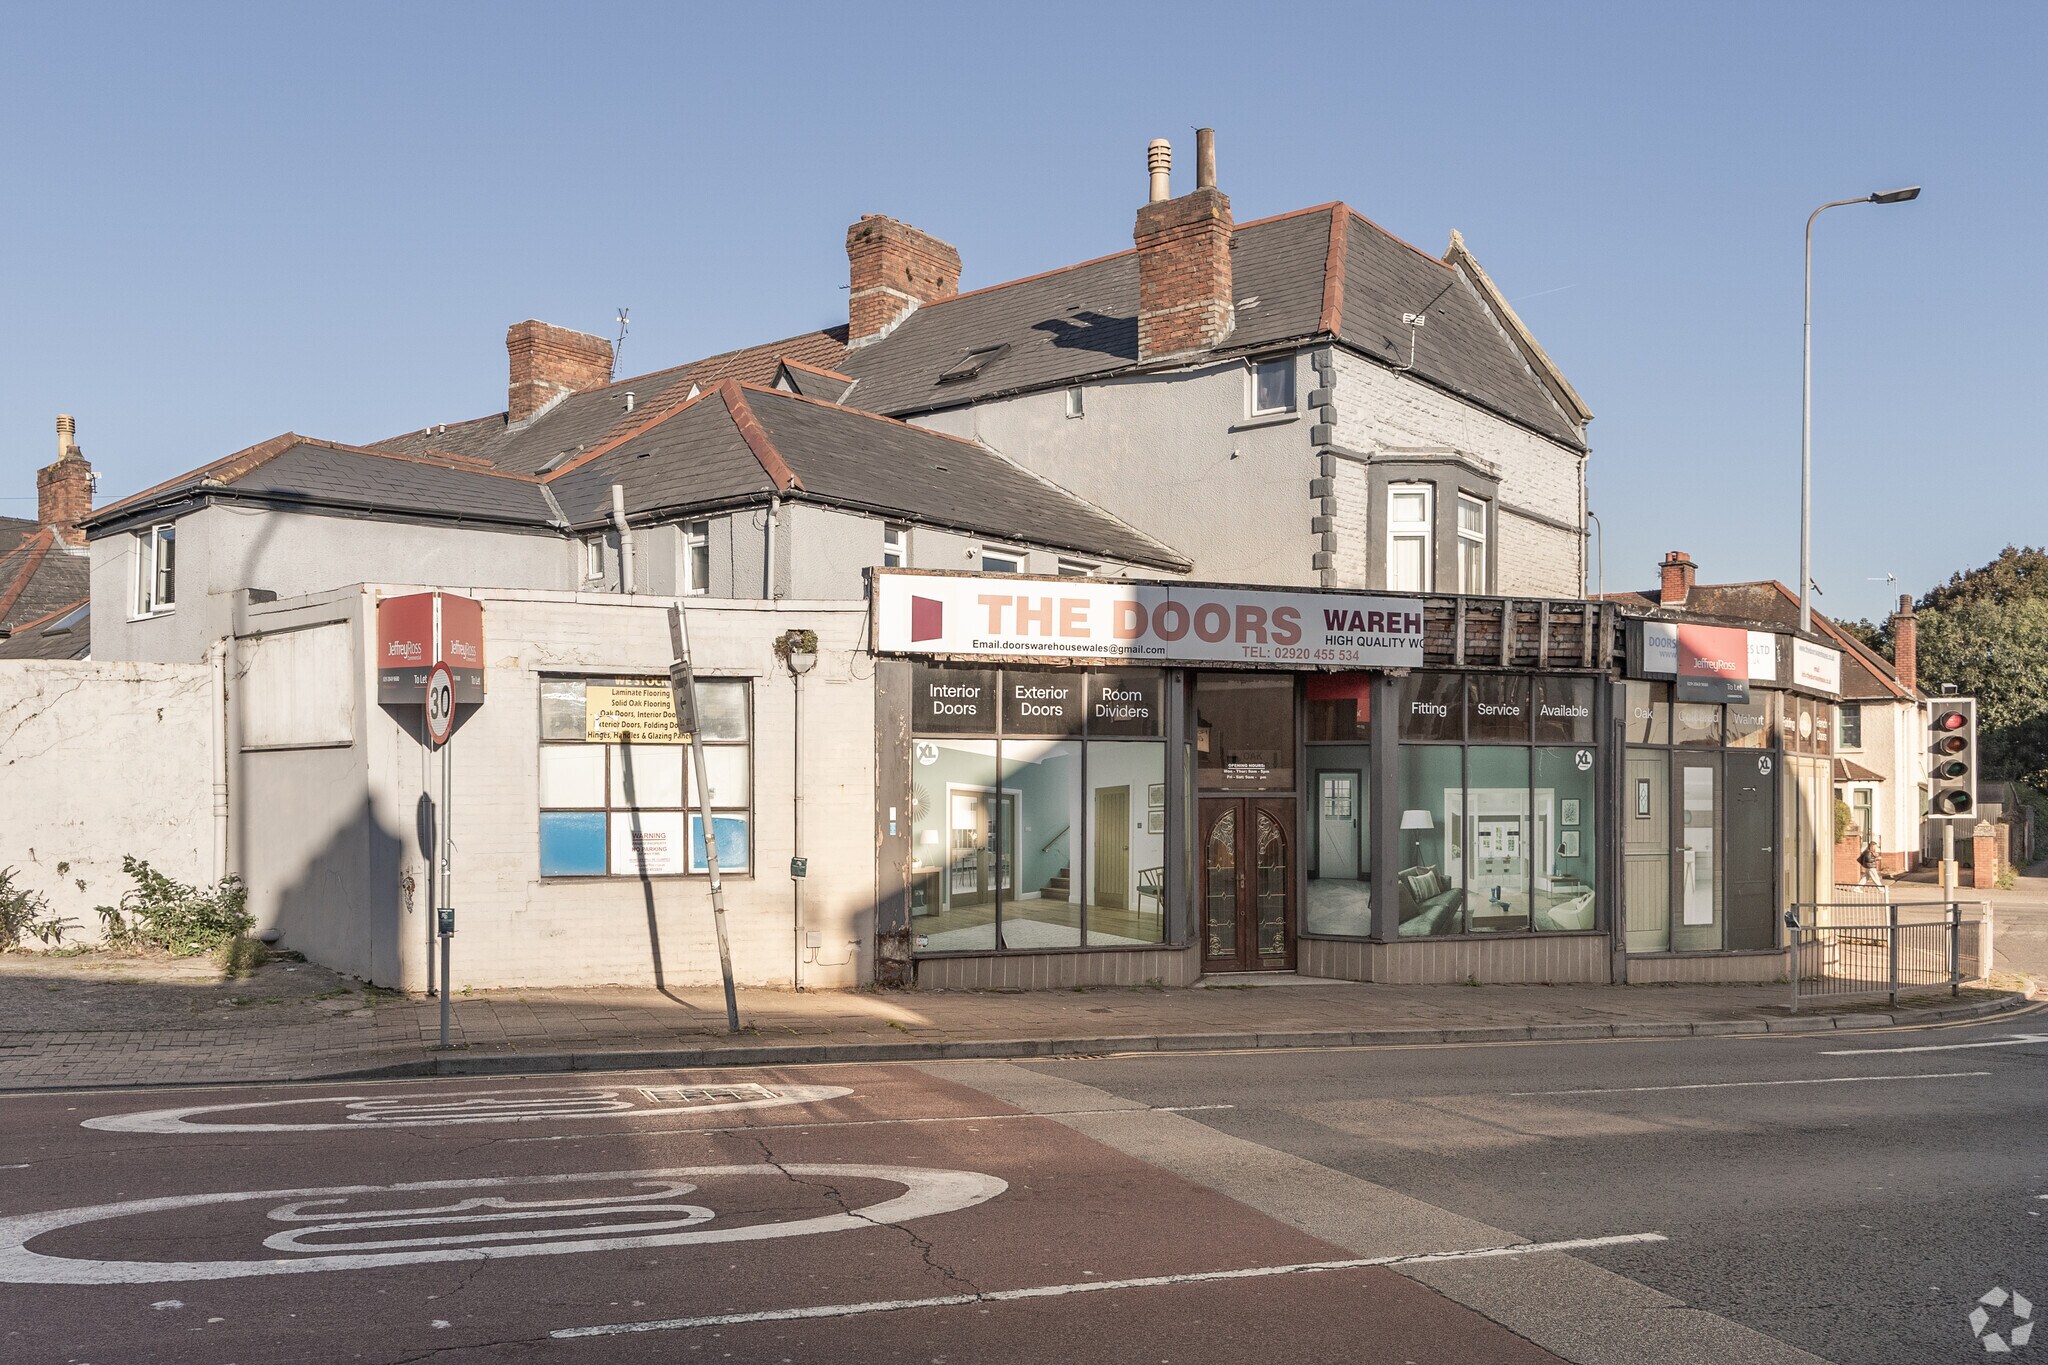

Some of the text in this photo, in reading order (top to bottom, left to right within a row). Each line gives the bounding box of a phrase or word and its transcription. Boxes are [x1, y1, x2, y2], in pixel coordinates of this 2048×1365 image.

[978, 594, 1302, 646] THE DOORS
[1323, 609, 1421, 634] WAREH
[972, 639, 1165, 655] Email.doorswarehousewales@gmail.com
[1325, 635, 1353, 646] HIGH
[1356, 636, 1405, 648] QUALITY
[1649, 636, 1677, 649] DOORS
[1756, 645, 1770, 655] LTD
[388, 640, 422, 659] JeffreyRoss
[450, 640, 476, 659] JeffreyRoss
[1242, 646, 1360, 662] TEL: 02920 455 534
[1693, 658, 1736, 672] JeffreyRoss
[414, 675, 428, 684] To Let
[615, 676, 669, 687] WE STOCK
[612, 689, 670, 698] Laminate Flooring
[929, 683, 981, 698] Interior
[1015, 685, 1068, 699] Exterior
[1727, 683, 1733, 691] To
[1102, 688, 1142, 701] Room
[430, 685, 450, 720] 30
[612, 699, 628, 707] Solid
[643, 700, 671, 709] Flooring
[933, 701, 977, 715] Doors
[1021, 702, 1063, 716] Doors
[637, 710, 662, 718] Interior
[1095, 704, 1149, 718] Dividers
[1411, 702, 1589, 718] Fitting Service Available
[1634, 707, 1653, 719] Oak
[621, 721, 641, 729] Doors,
[643, 721, 668, 730] Folding
[1734, 713, 1764, 726] Walnut
[587, 732, 612, 740] Hinges,
[648, 732, 672, 741] Glazing
[918, 744, 936, 760] XL
[262, 1181, 716, 1253] 30
